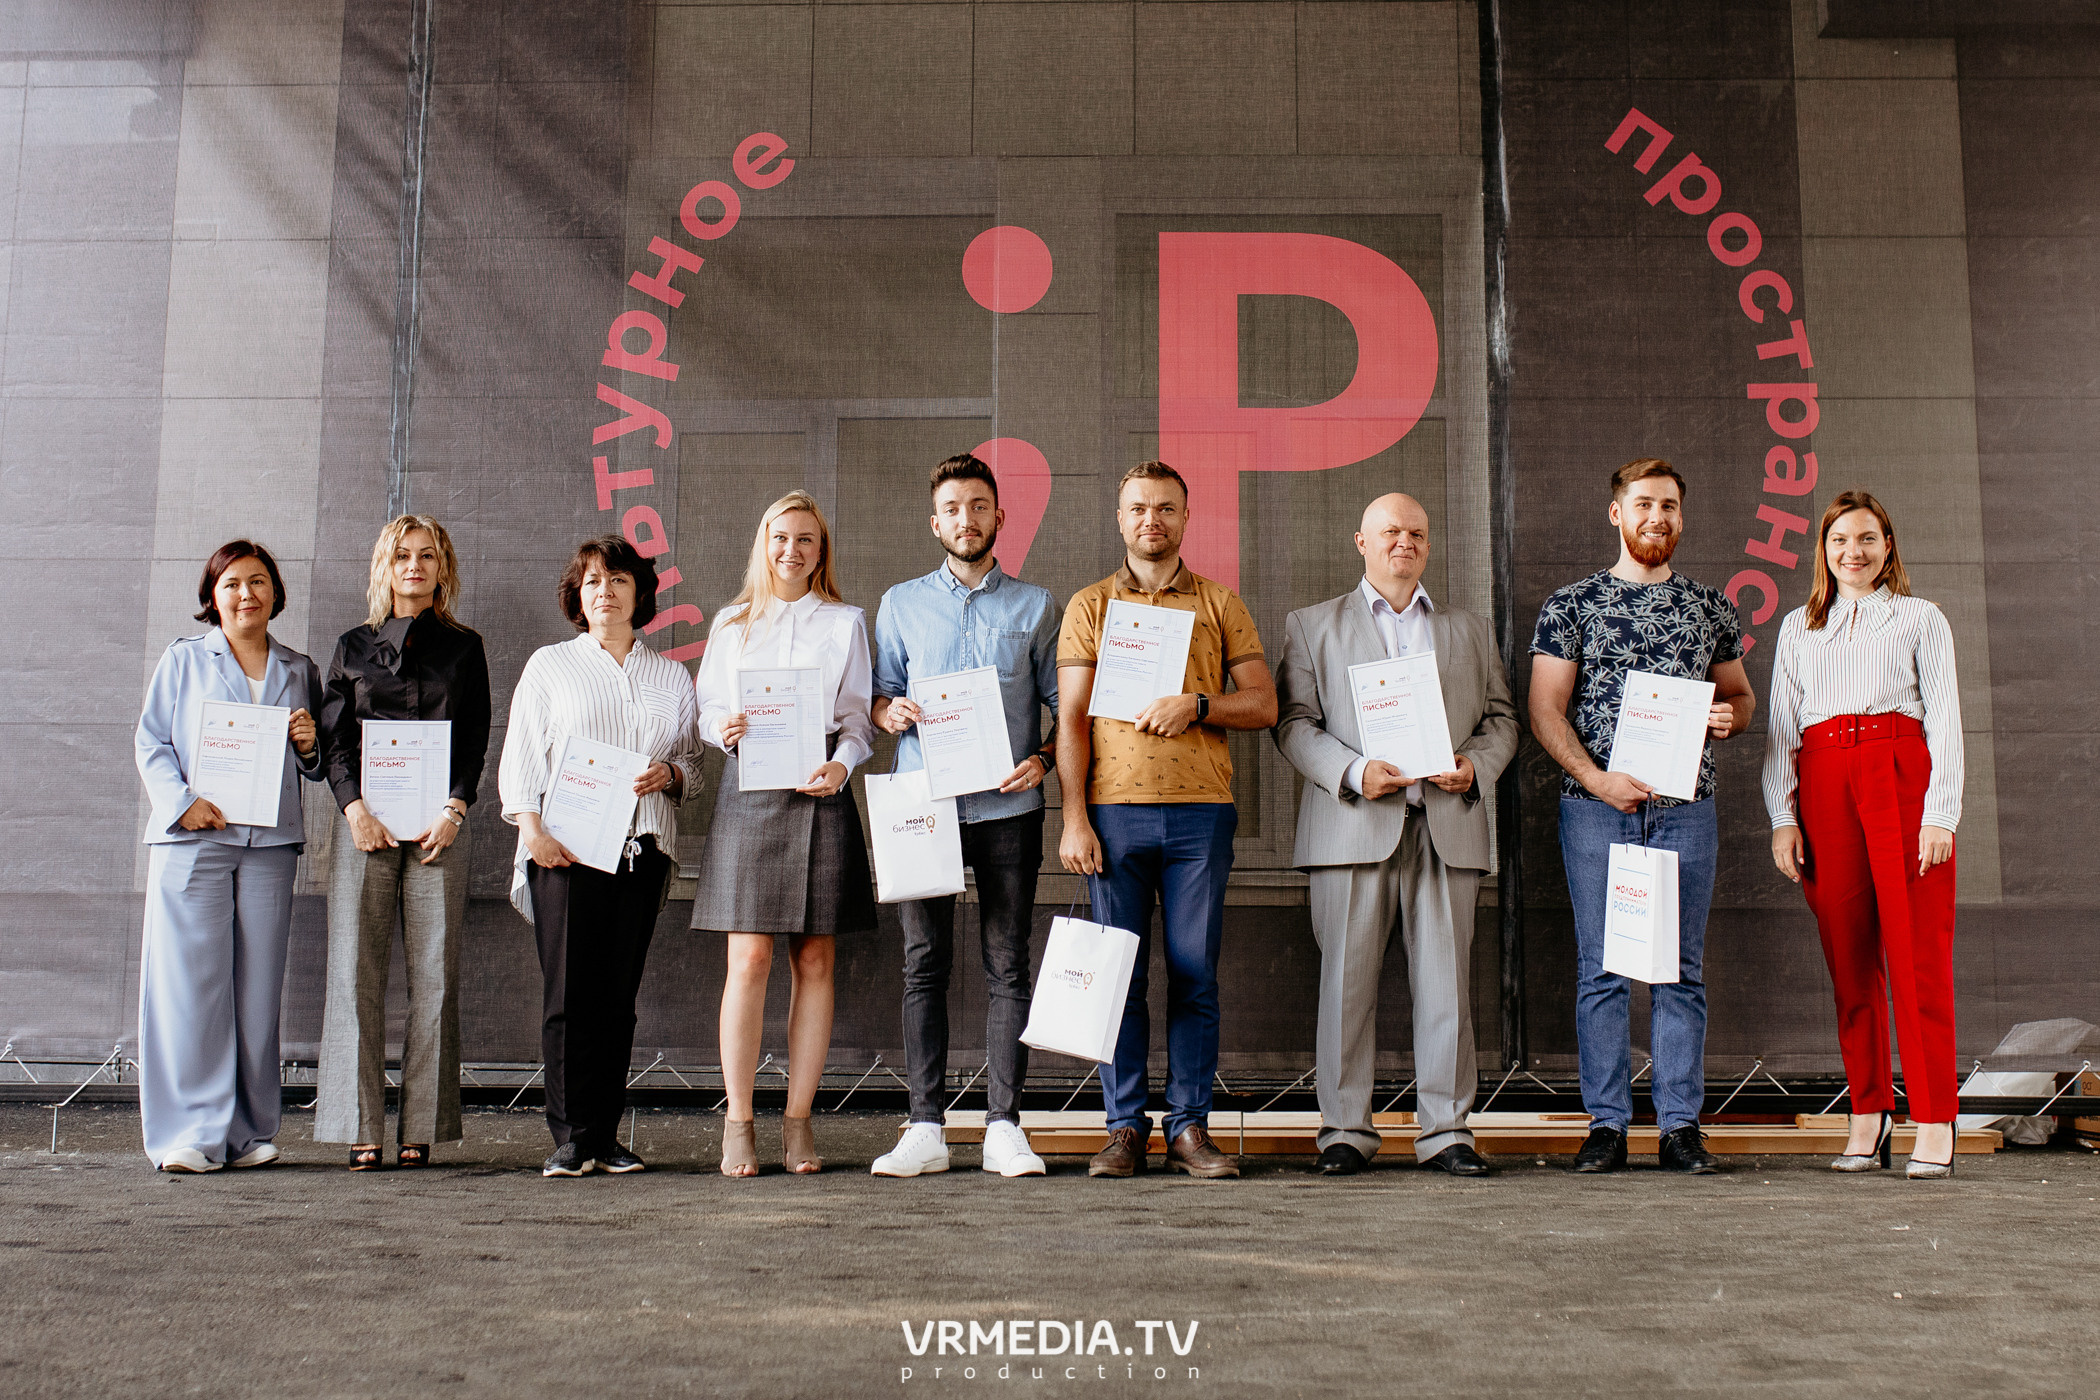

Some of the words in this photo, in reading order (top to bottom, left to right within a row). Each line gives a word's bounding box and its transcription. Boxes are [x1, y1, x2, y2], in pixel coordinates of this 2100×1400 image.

[1604, 107, 1820, 659] пространс
[1109, 639, 1145, 651] ПИСЬМО
[745, 708, 781, 716] ПИСЬМО
[1362, 700, 1399, 712] ПИСЬМО
[923, 714, 961, 726] ПИСЬМО
[1627, 710, 1663, 722] ПИСЬМО
[203, 741, 241, 750] ПИСЬМО
[561, 774, 597, 789] ПИСЬМО
[906, 815, 925, 825] мой
[892, 824, 926, 833] бизнес
[1615, 885, 1648, 900] МОЛОДОЙ
[1614, 900, 1646, 917] РОССИИ
[1064, 969, 1083, 978] мой
